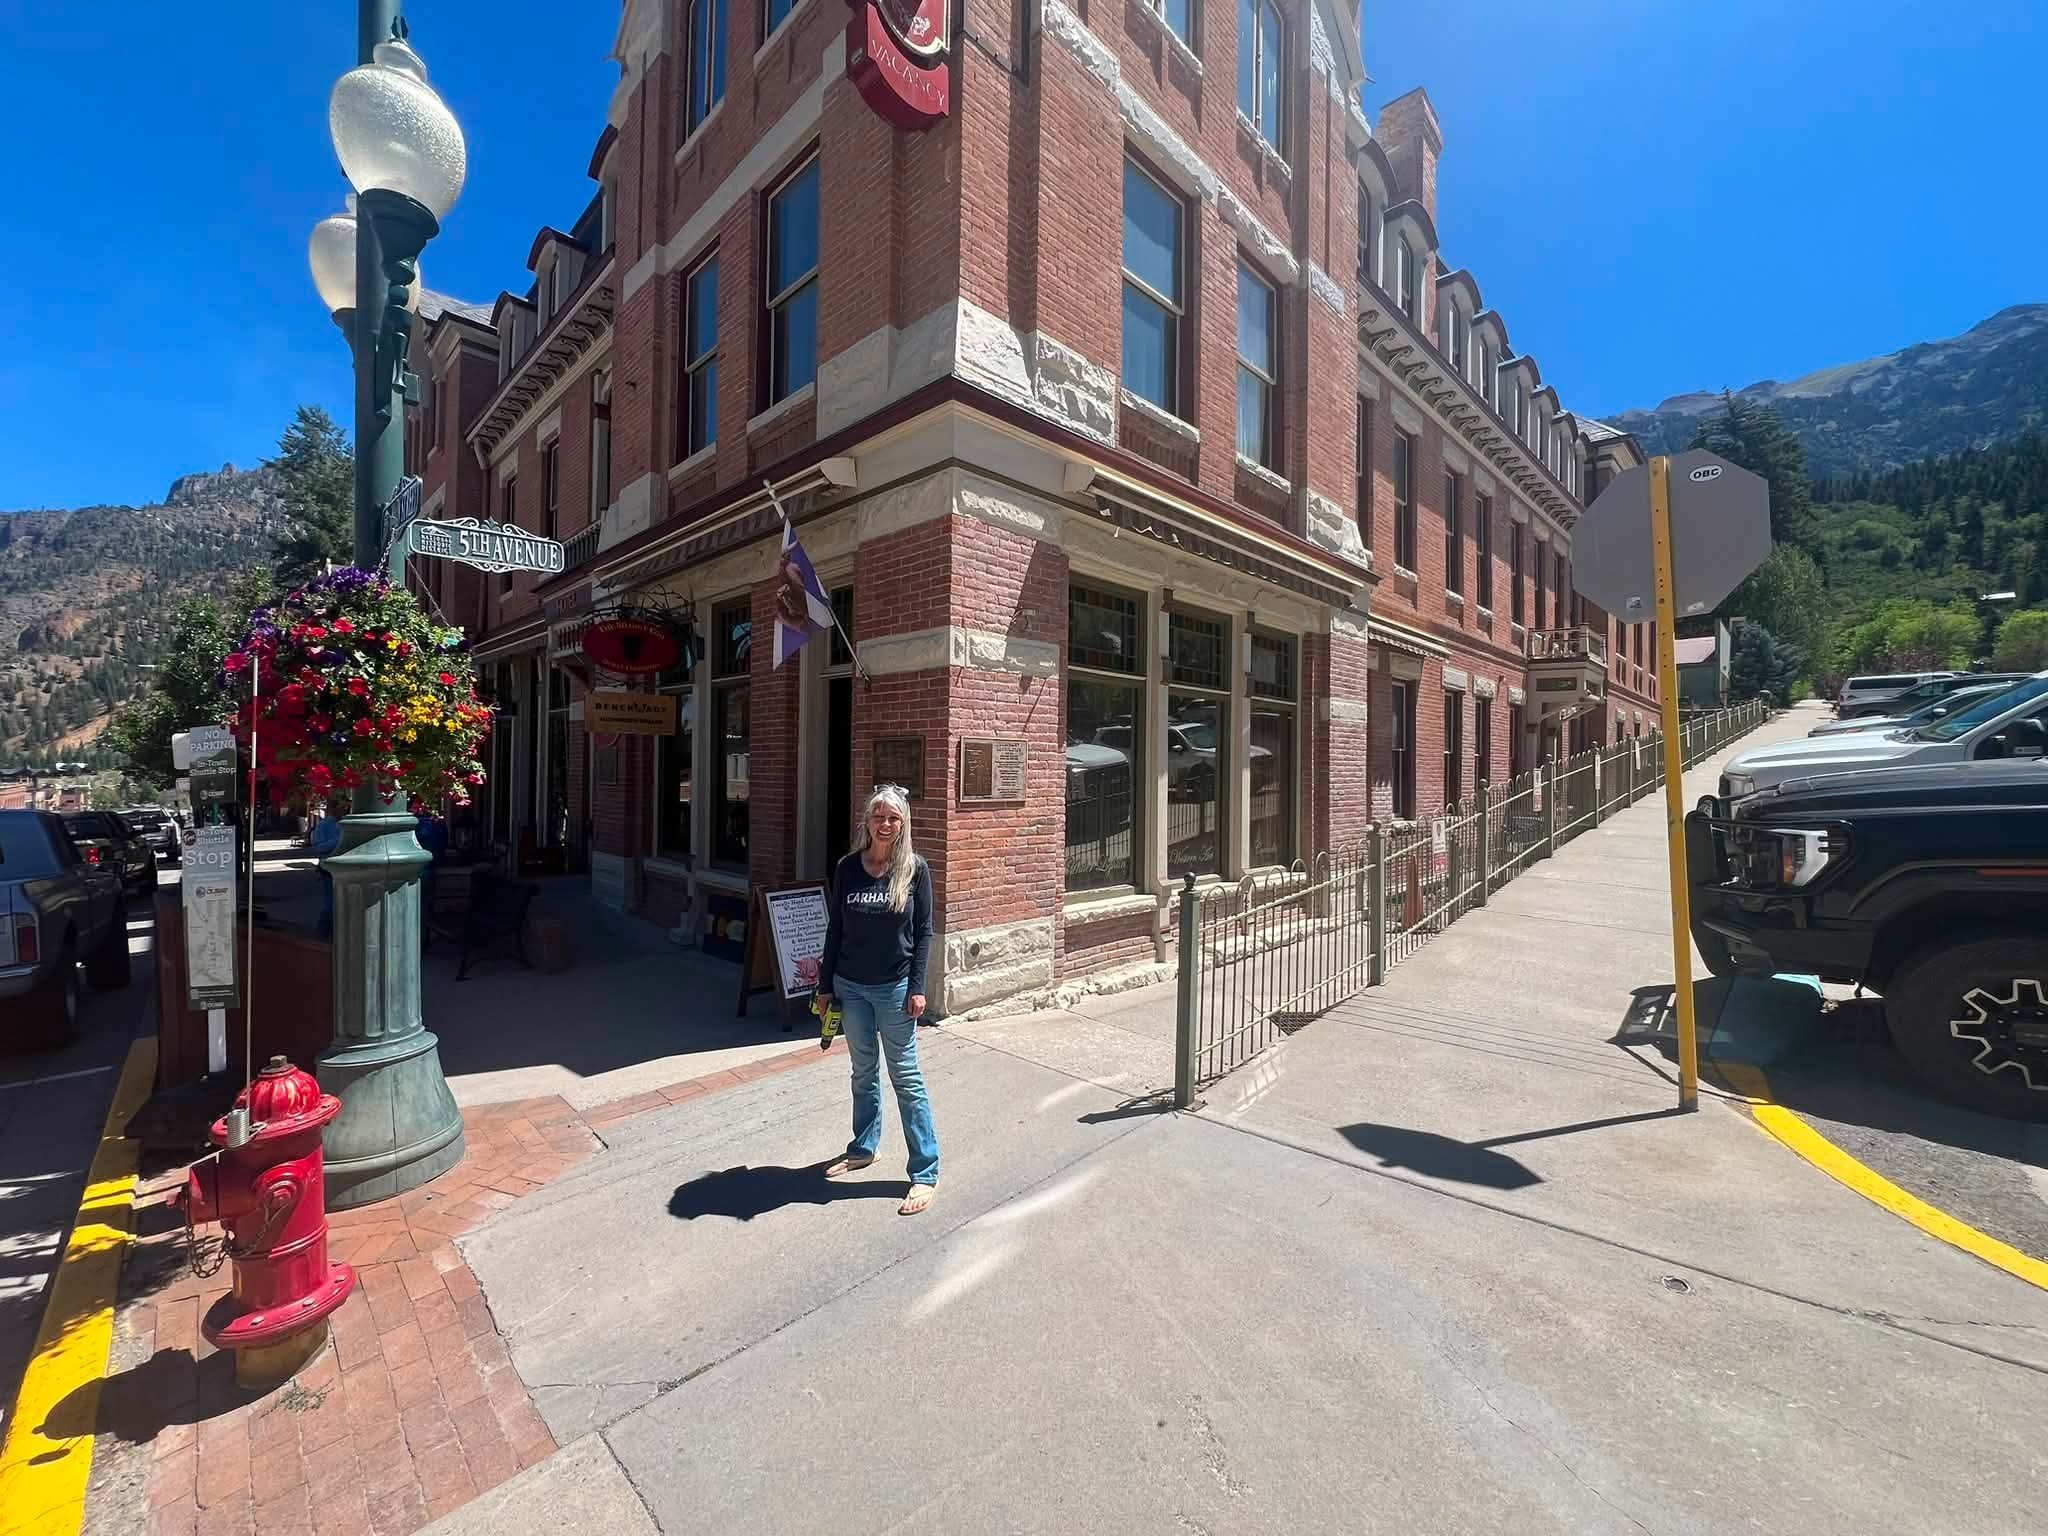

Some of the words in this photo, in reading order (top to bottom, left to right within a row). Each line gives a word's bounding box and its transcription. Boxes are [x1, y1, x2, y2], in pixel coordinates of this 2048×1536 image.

[872, 40, 945, 106] VACANCY
[1693, 468, 1720, 479] OBC
[459, 530, 490, 557] 5TH
[492, 536, 559, 569] AVENUE
[204, 730, 220, 740] NO
[190, 740, 235, 752] PARKING
[218, 766, 237, 776] Stop
[197, 827, 233, 836] In-Town
[185, 849, 232, 868] Stop
[847, 892, 891, 904] CARHAR
